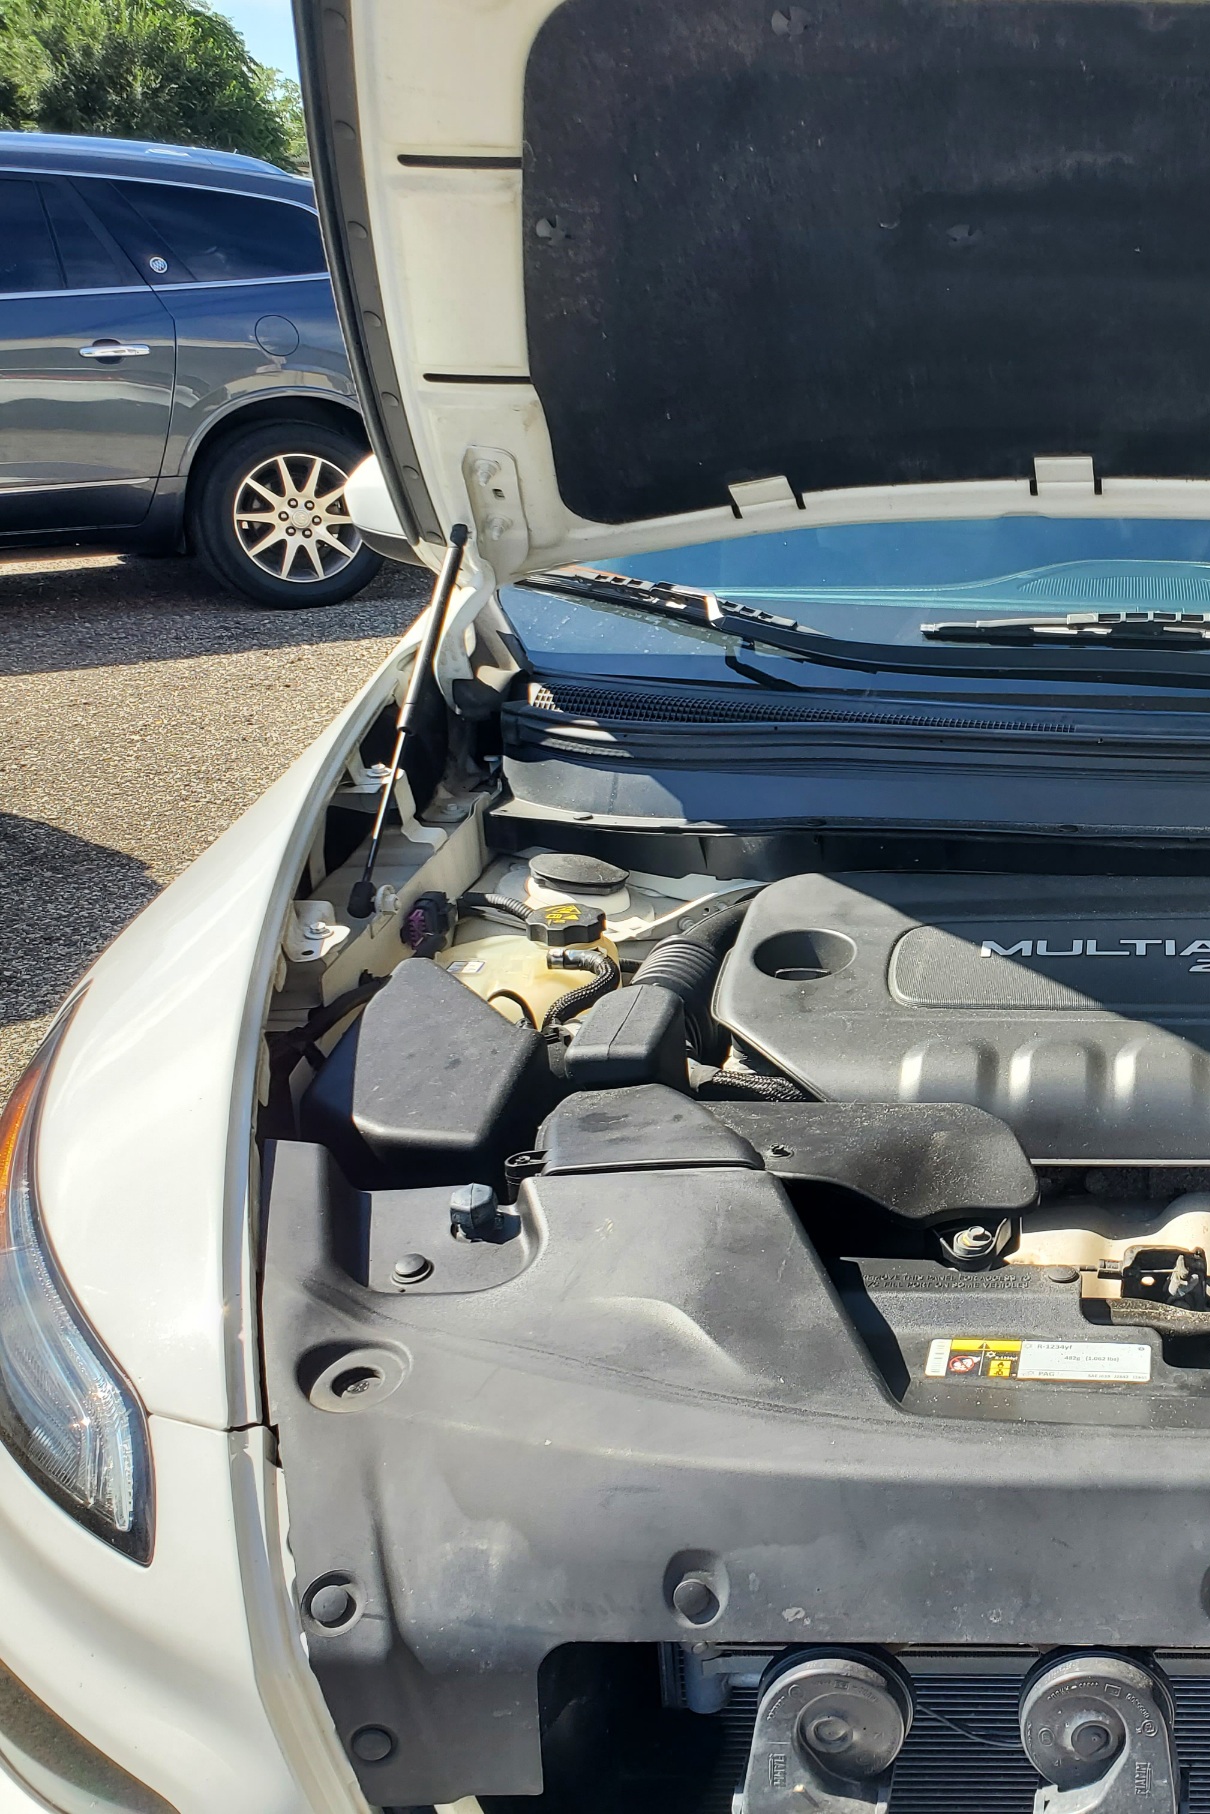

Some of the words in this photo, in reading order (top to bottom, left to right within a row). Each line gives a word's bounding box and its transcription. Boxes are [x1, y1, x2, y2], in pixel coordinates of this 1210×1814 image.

[903, 1274, 924, 1282] THIS
[927, 1274, 956, 1282] PANEL
[958, 1274, 978, 1282] FOR
[980, 1274, 1016, 1282] ACCESS
[1037, 1343, 1073, 1351] R-1234yf
[1135, 1762, 1147, 1795] FIAMM
